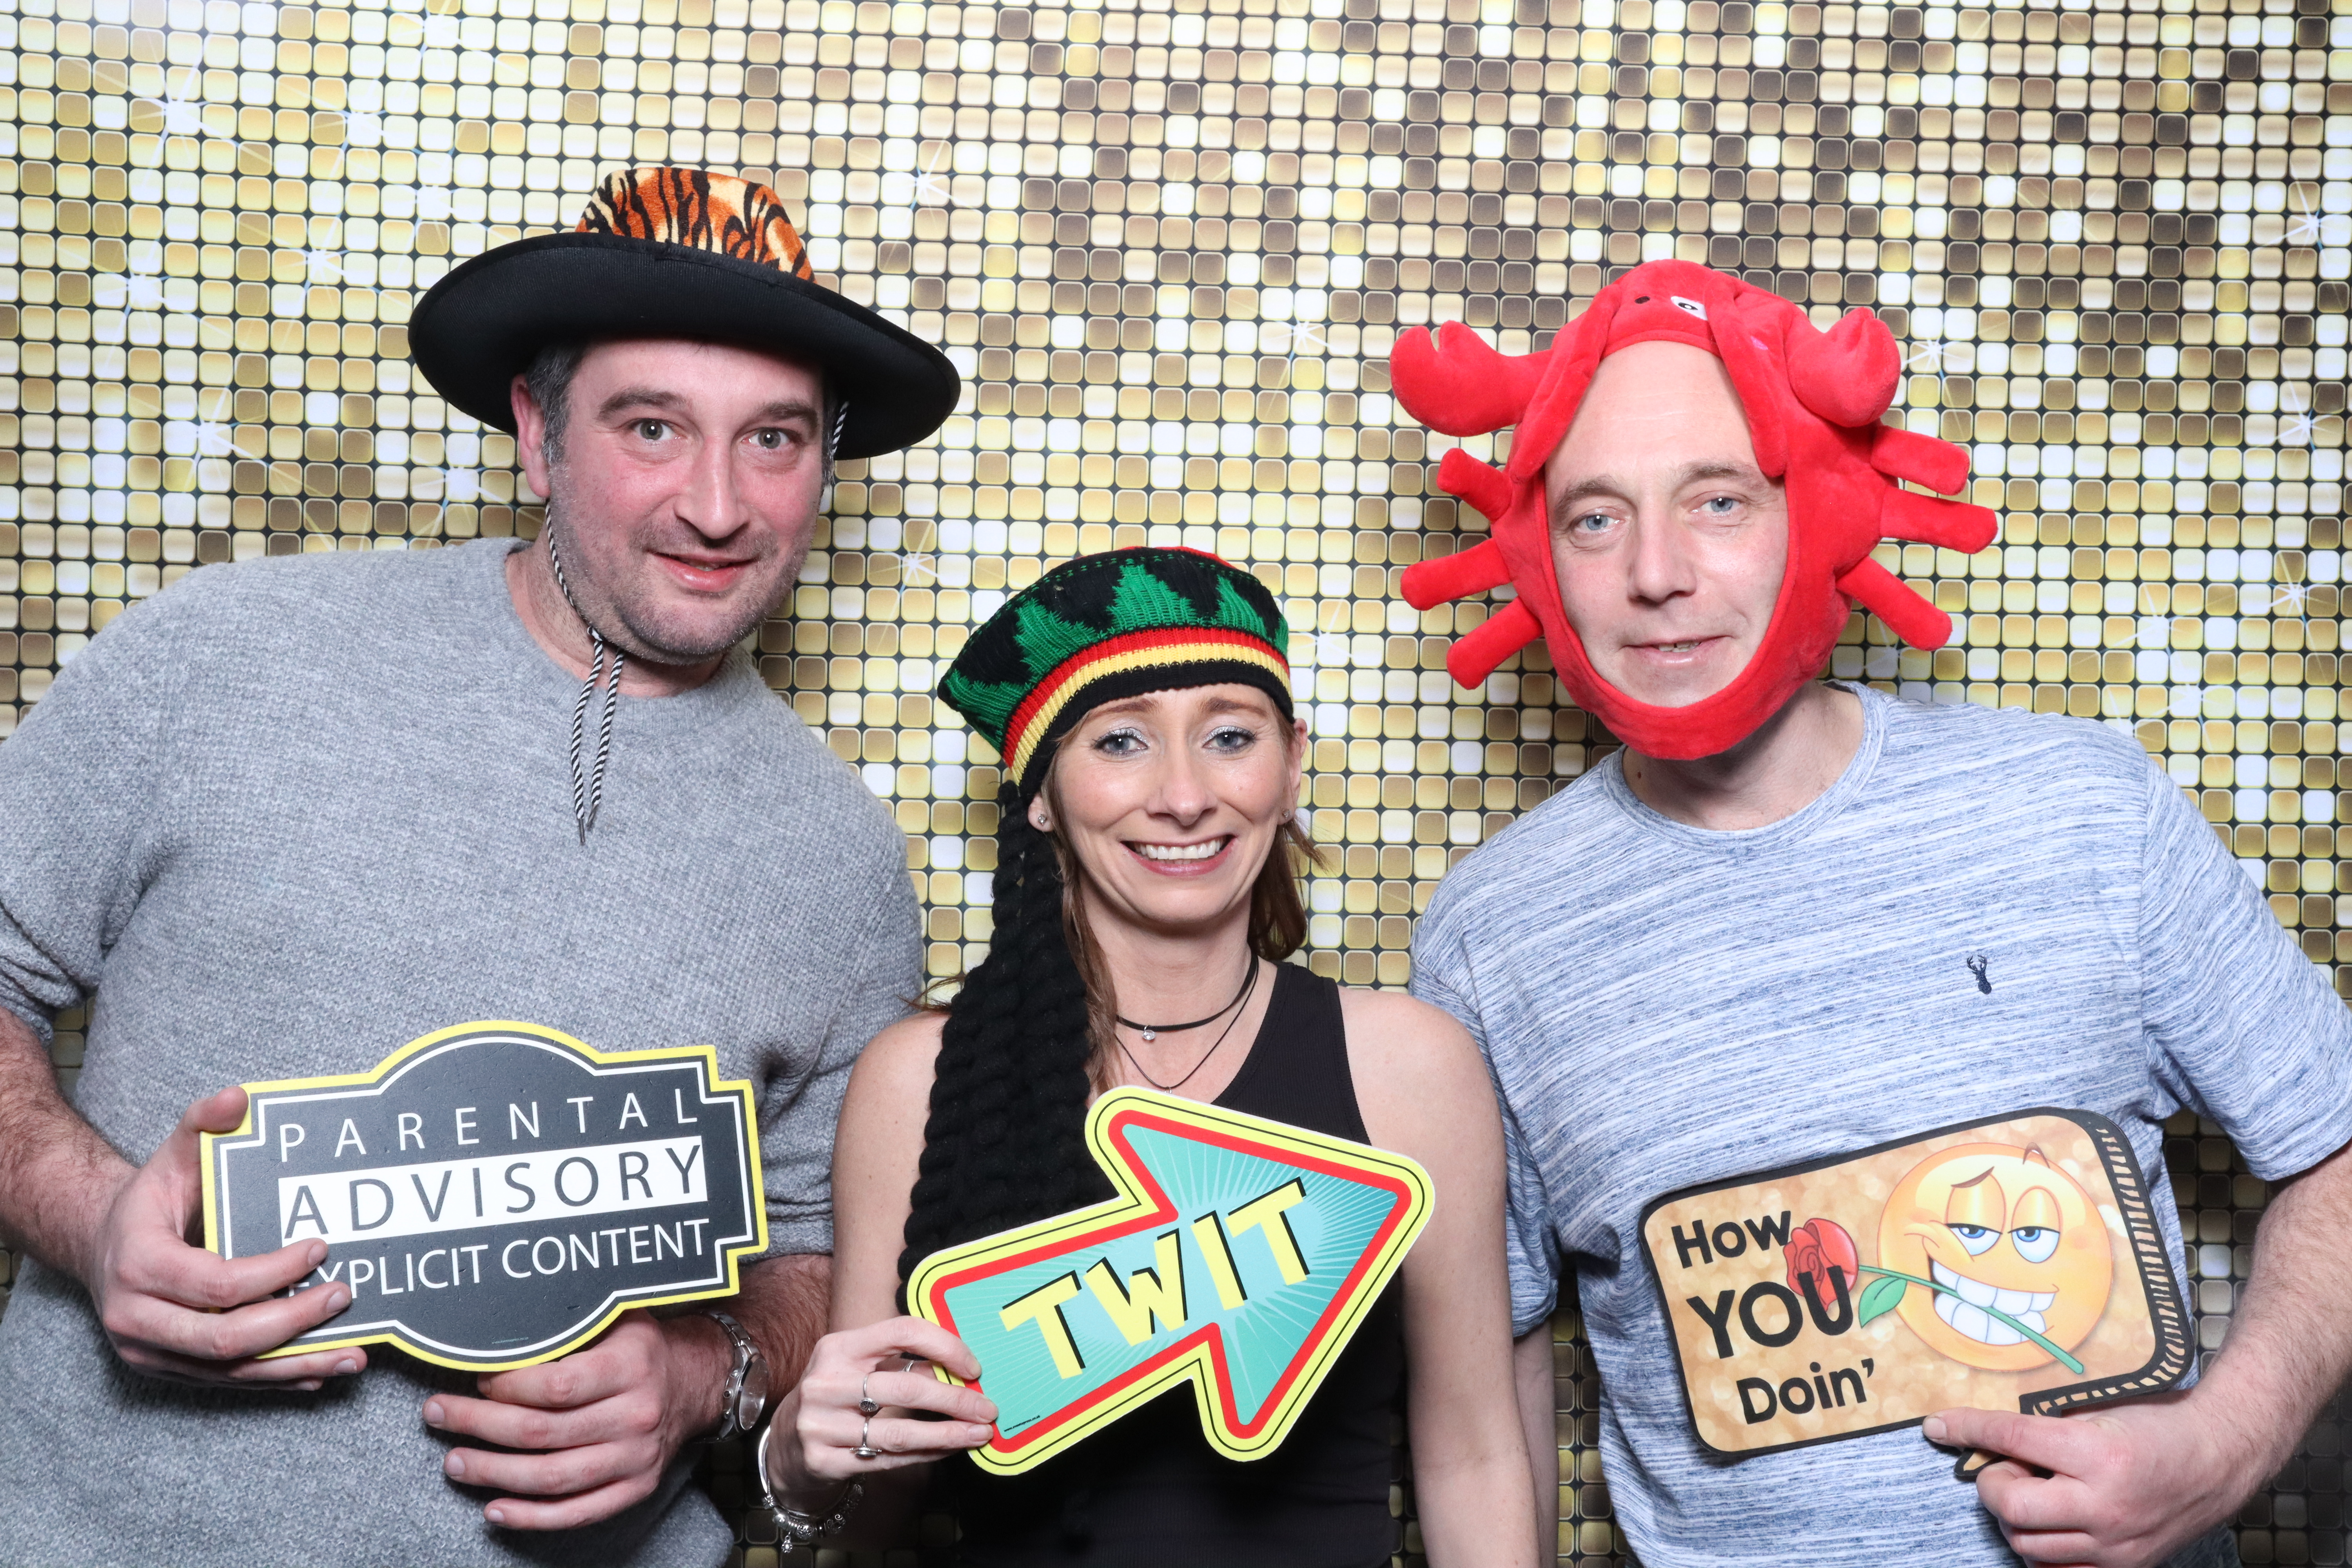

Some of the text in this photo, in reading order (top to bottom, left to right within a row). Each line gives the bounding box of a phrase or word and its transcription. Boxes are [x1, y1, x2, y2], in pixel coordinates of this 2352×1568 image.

[279, 1088, 698, 1163] PARENTAL
[284, 1144, 701, 1239] ADVISORY
[288, 1218, 710, 1299] PLICIT CONTENT
[998, 1176, 1310, 1379] TWIT
[1671, 1210, 1791, 1269] How
[1686, 1265, 1854, 1359] YOU
